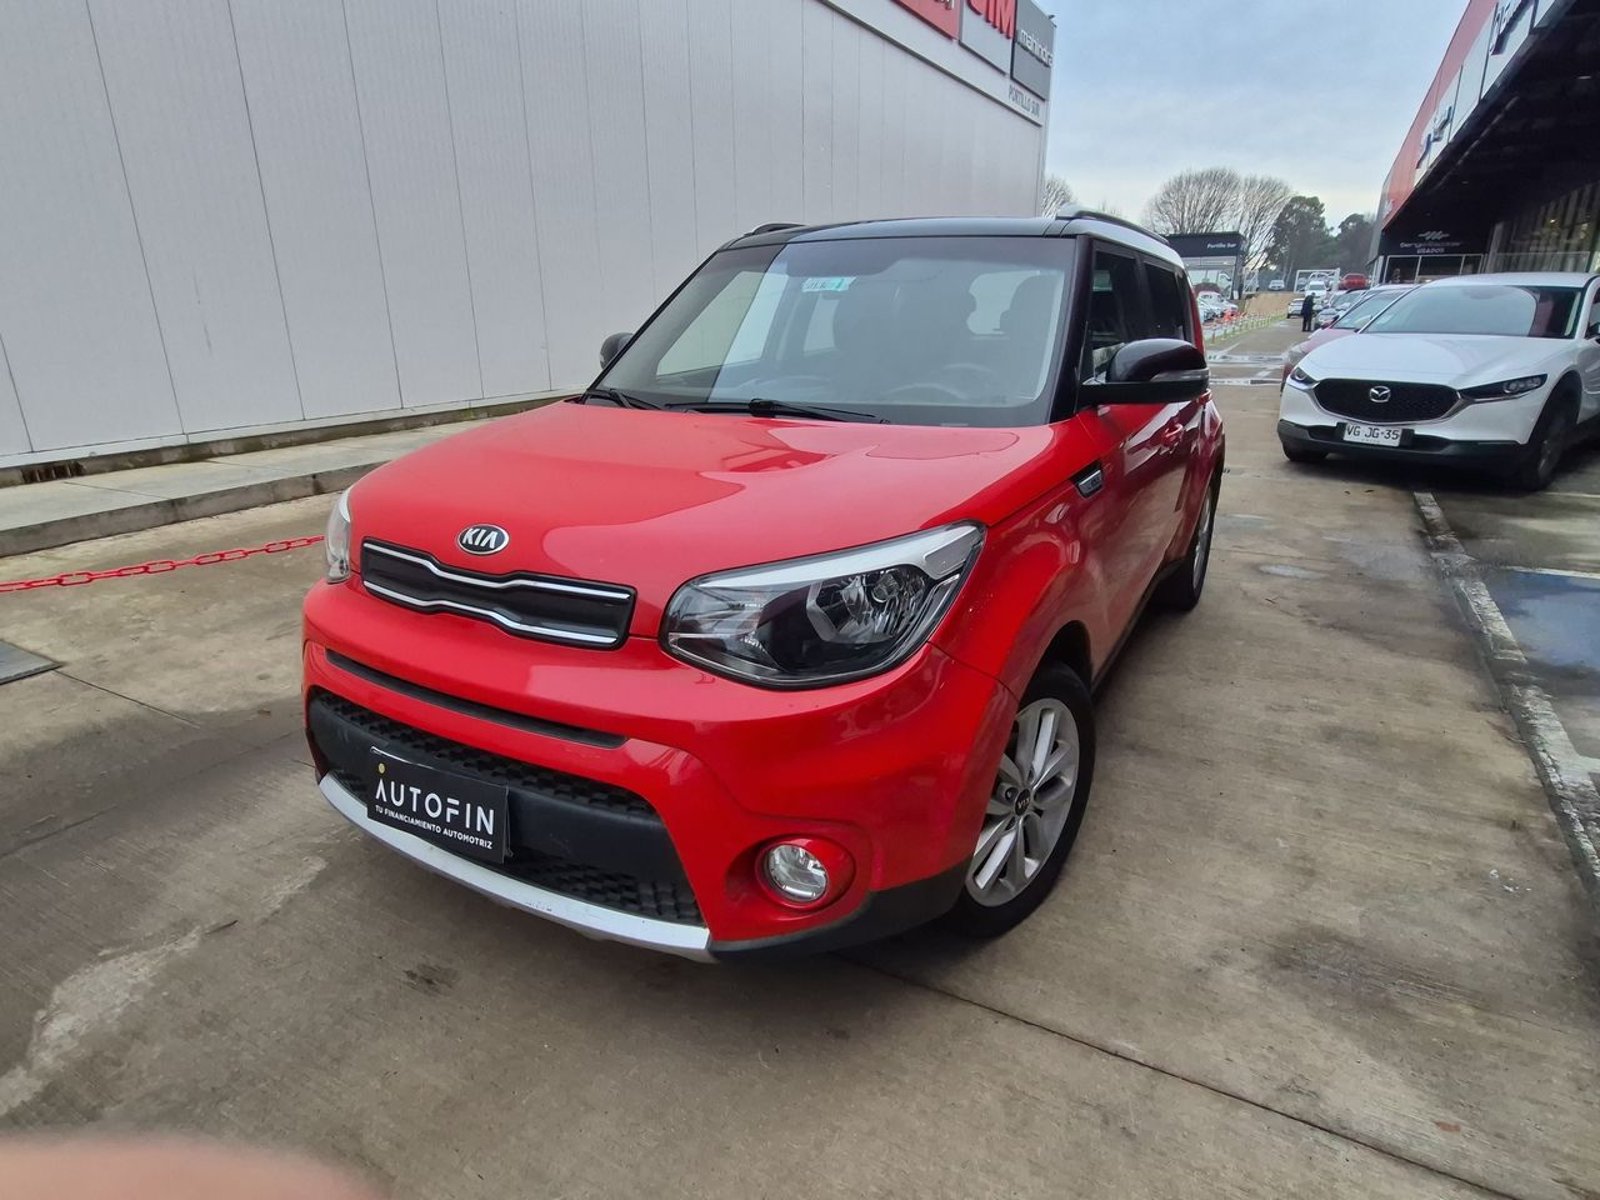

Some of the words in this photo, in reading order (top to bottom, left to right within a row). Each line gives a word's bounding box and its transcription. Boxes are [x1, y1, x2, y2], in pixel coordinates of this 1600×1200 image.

[1346, 425, 1361, 436] VG
[462, 528, 498, 549] KIA
[375, 778, 495, 835] AUTOFIN
[375, 804, 384, 814] TU
[384, 808, 442, 833] FINANCIAMIENTO
[443, 829, 493, 850] AUTOMOTRIZ
